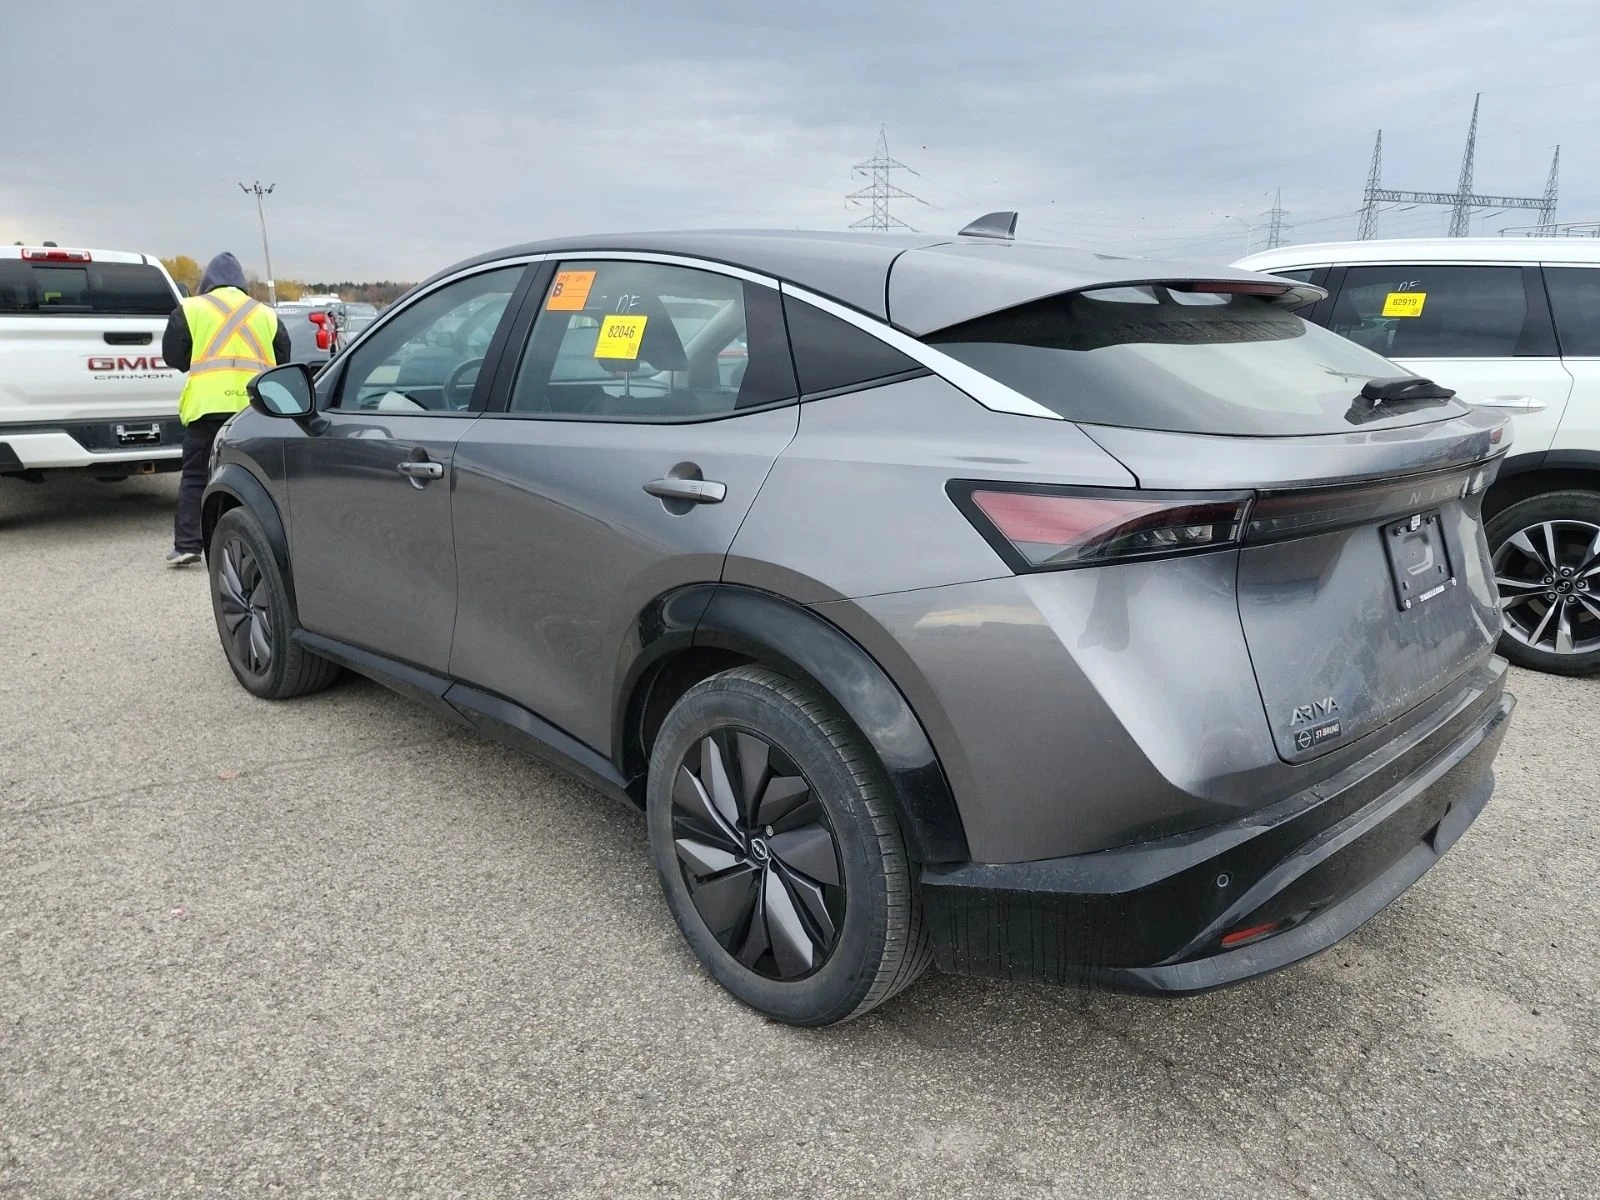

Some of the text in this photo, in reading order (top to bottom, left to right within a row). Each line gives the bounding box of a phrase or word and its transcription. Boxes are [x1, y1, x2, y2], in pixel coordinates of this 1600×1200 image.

[552, 282, 564, 297] B
[1392, 298, 1418, 306] 82919
[607, 325, 636, 339] 82046
[88, 356, 177, 371] GMC
[1290, 696, 1339, 726] ARIYA
